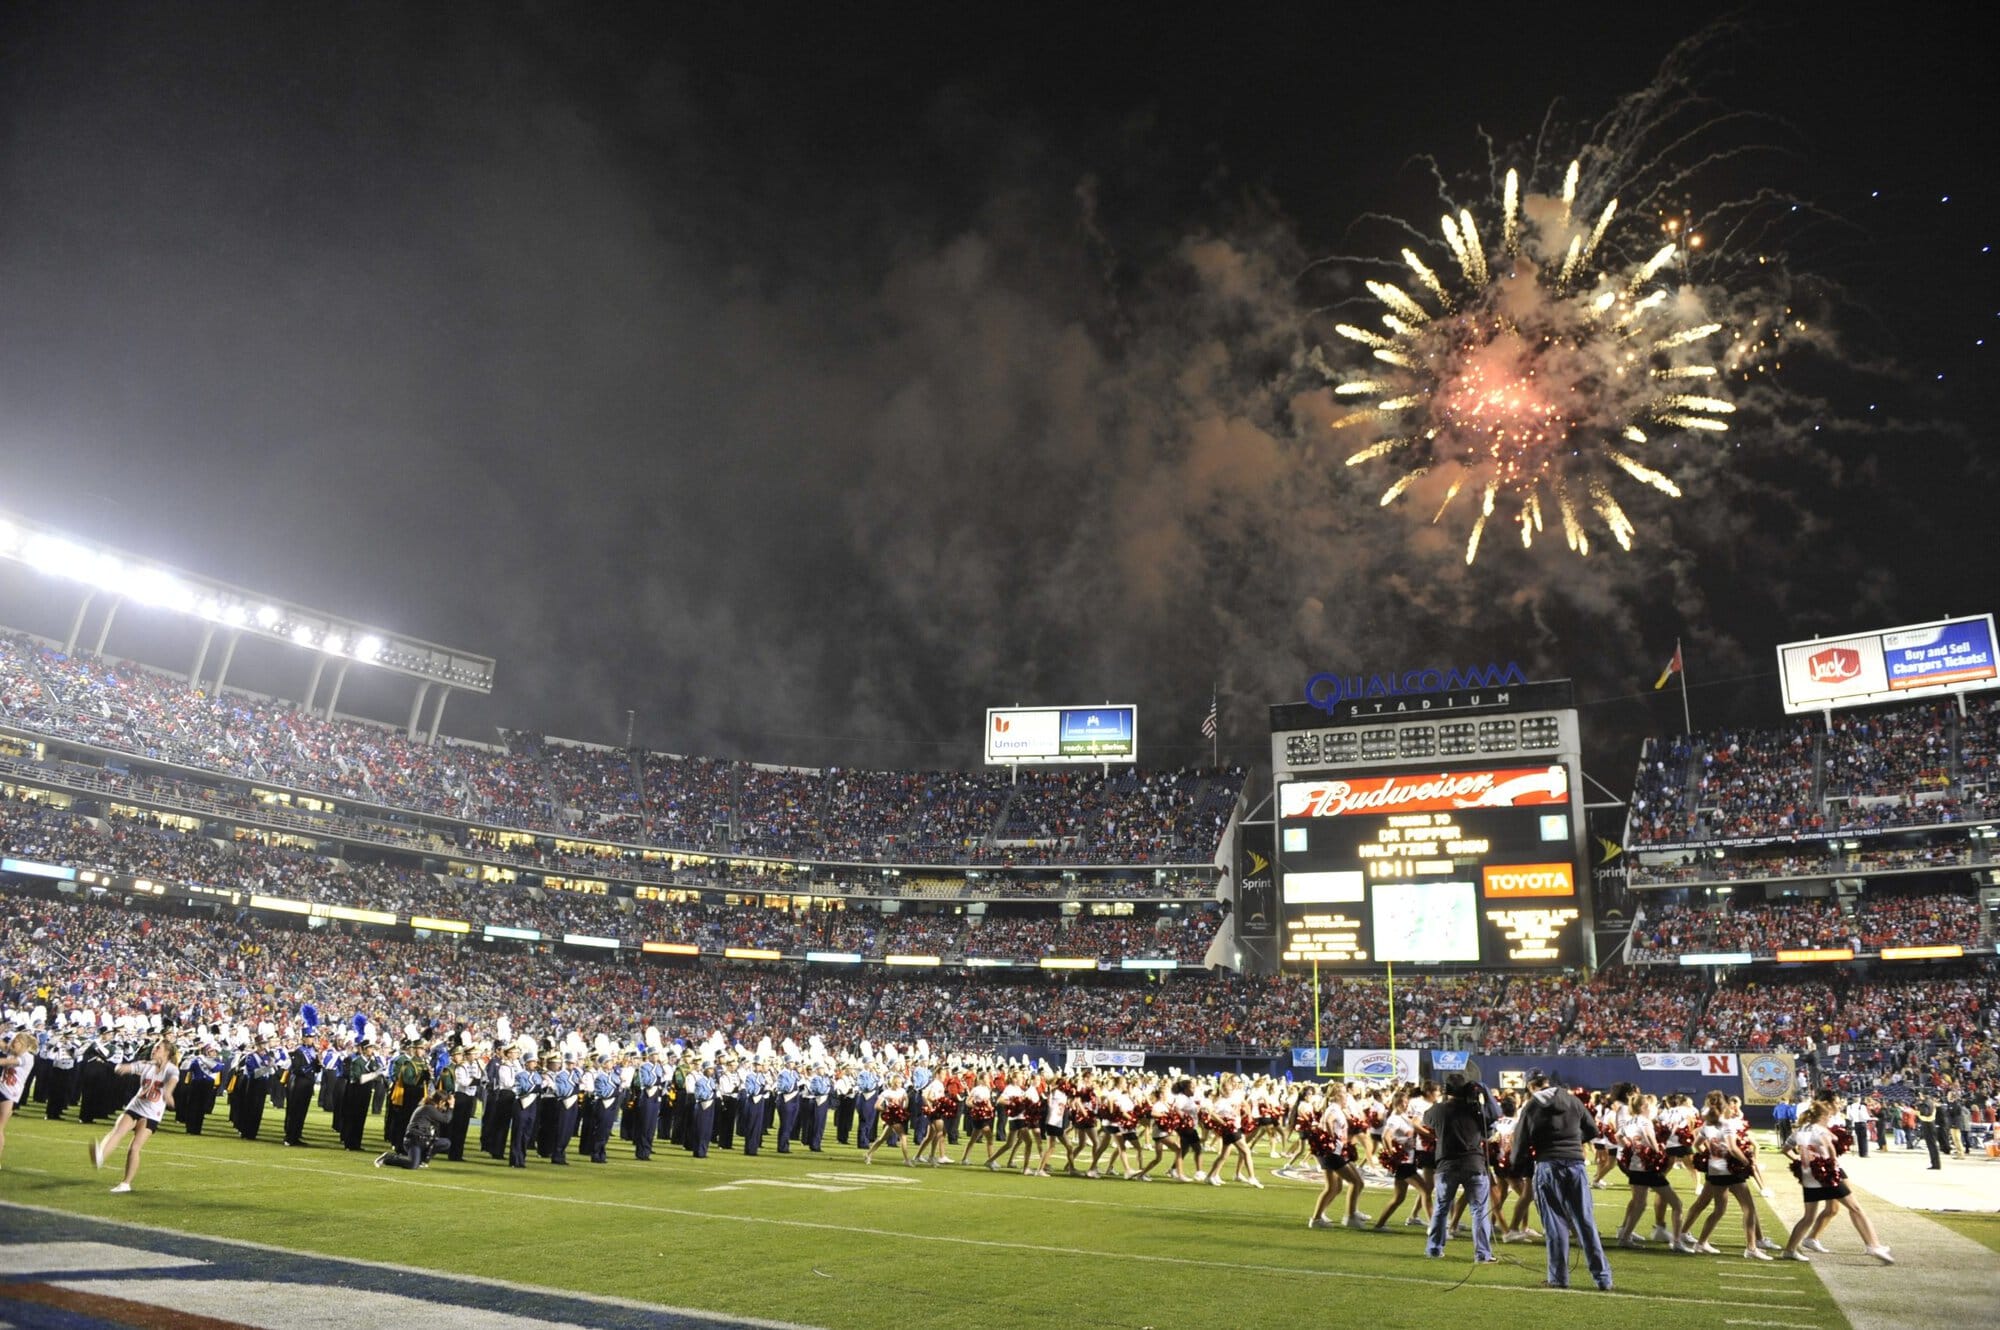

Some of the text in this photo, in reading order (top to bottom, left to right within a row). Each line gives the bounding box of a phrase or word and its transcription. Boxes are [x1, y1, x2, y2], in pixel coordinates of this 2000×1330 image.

[1905, 641, 1971, 661] Buy and Sell
[1812, 652, 1860, 682] Jack
[1893, 652, 1988, 675] Chargers Tickets!
[1304, 661, 1528, 716] QUALCOMM
[1351, 692, 1510, 716] STADIUM
[994, 740, 1028, 749] Union
[1311, 772, 1494, 818] Budweiser
[1434, 813, 1452, 826] TO
[1379, 826, 1461, 843] DR PEPPER
[1358, 841, 1438, 858] HALFTIME
[1242, 878, 1273, 891] Sprint
[1487, 871, 1570, 891] TOYOTA
[1386, 1055, 1401, 1066] LIE
[1707, 1055, 1731, 1074] N
